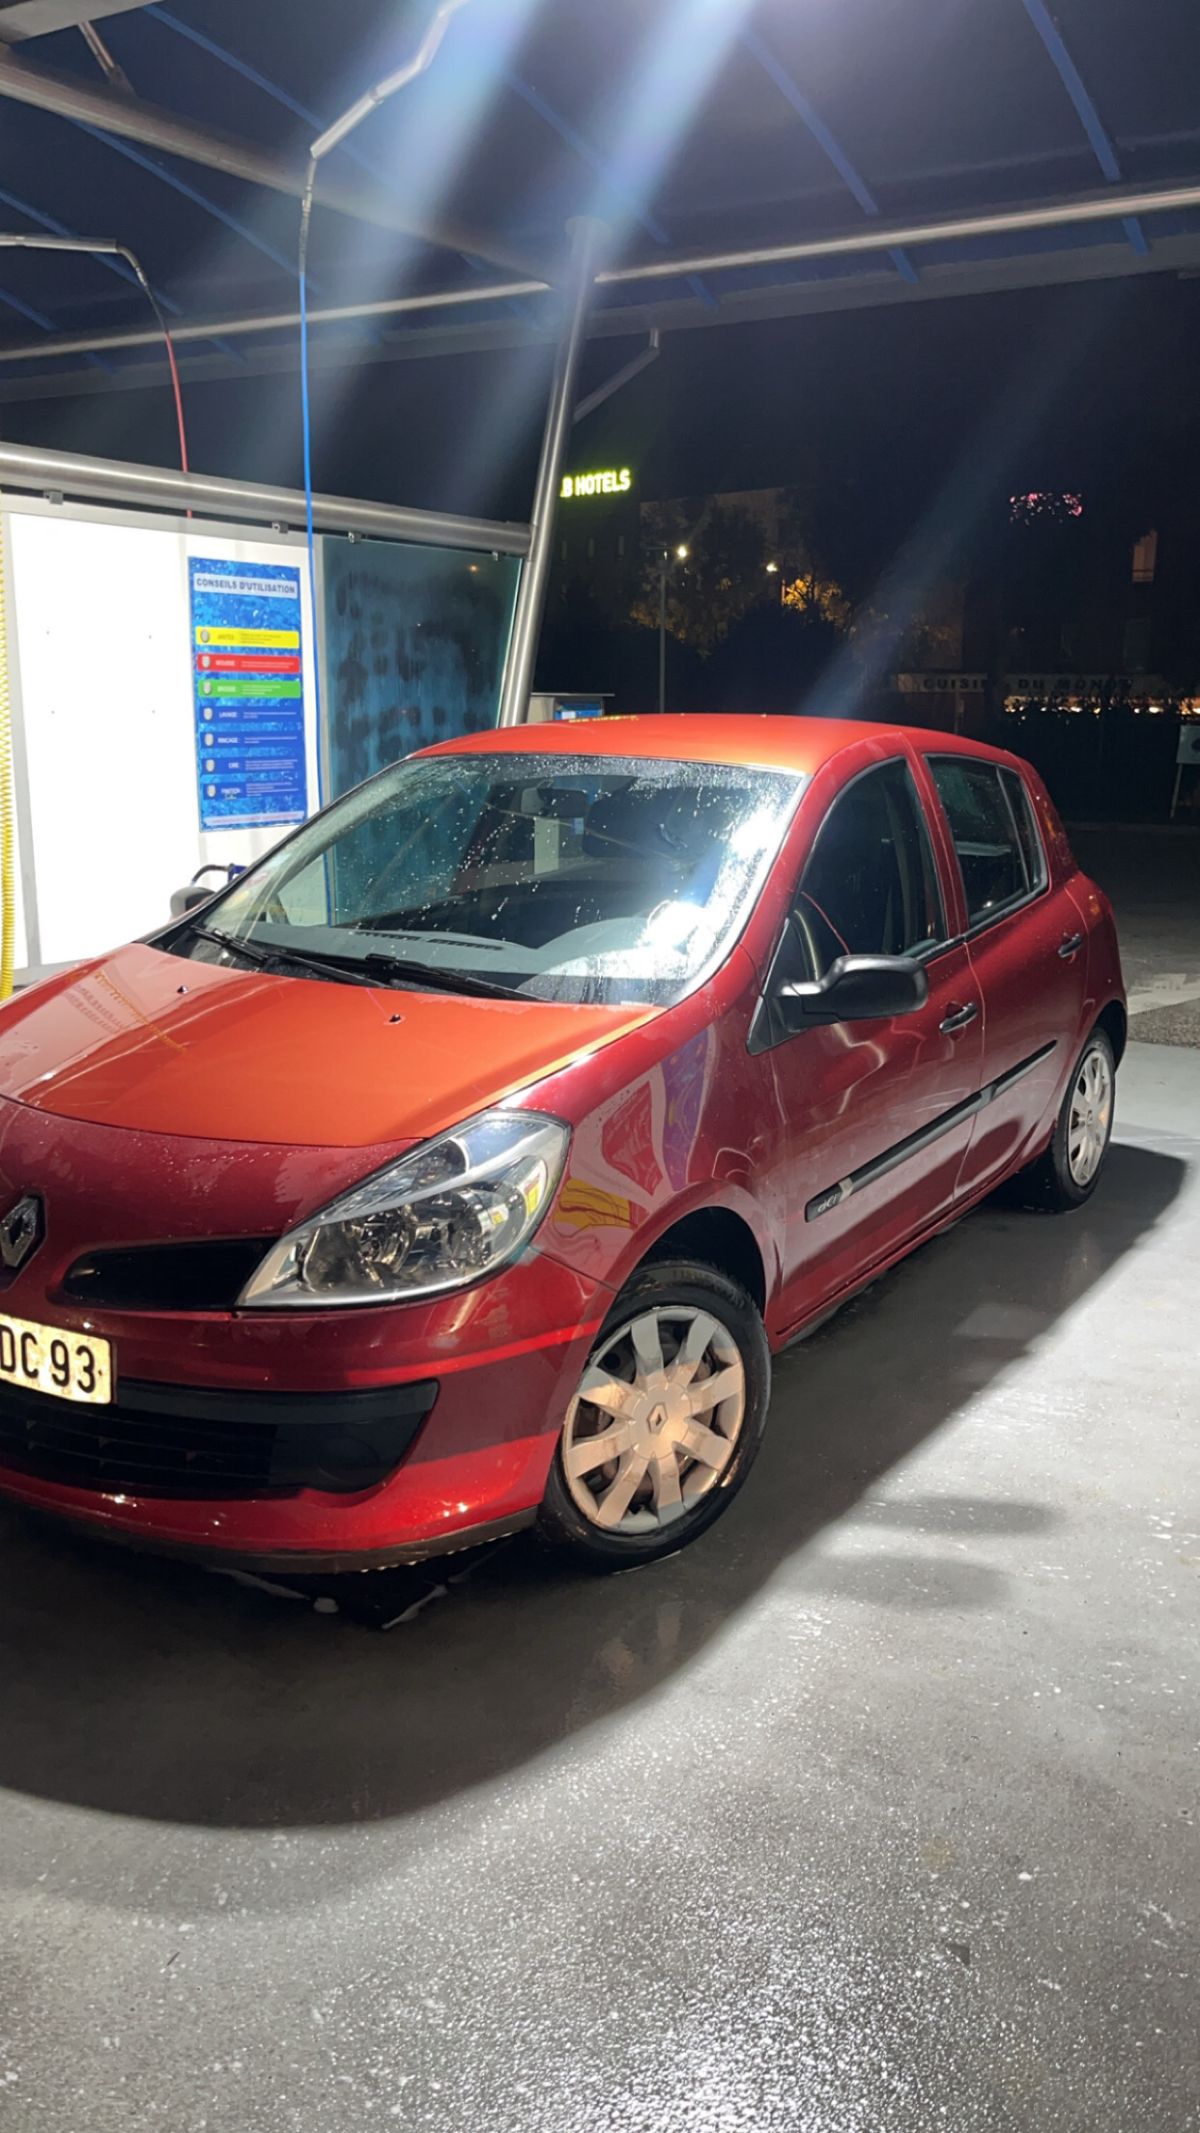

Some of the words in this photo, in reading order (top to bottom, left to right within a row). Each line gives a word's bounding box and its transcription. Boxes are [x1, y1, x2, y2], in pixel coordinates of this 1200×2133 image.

[575, 468, 631, 496] HOTELS
[196, 577, 237, 590] CONSEILS
[239, 581, 295, 594] D'UTILISATION
[923, 678, 987, 690] CUISI
[1016, 679, 1043, 690] DU
[0, 1323, 39, 1379] DC
[50, 1339, 96, 1394] 93
